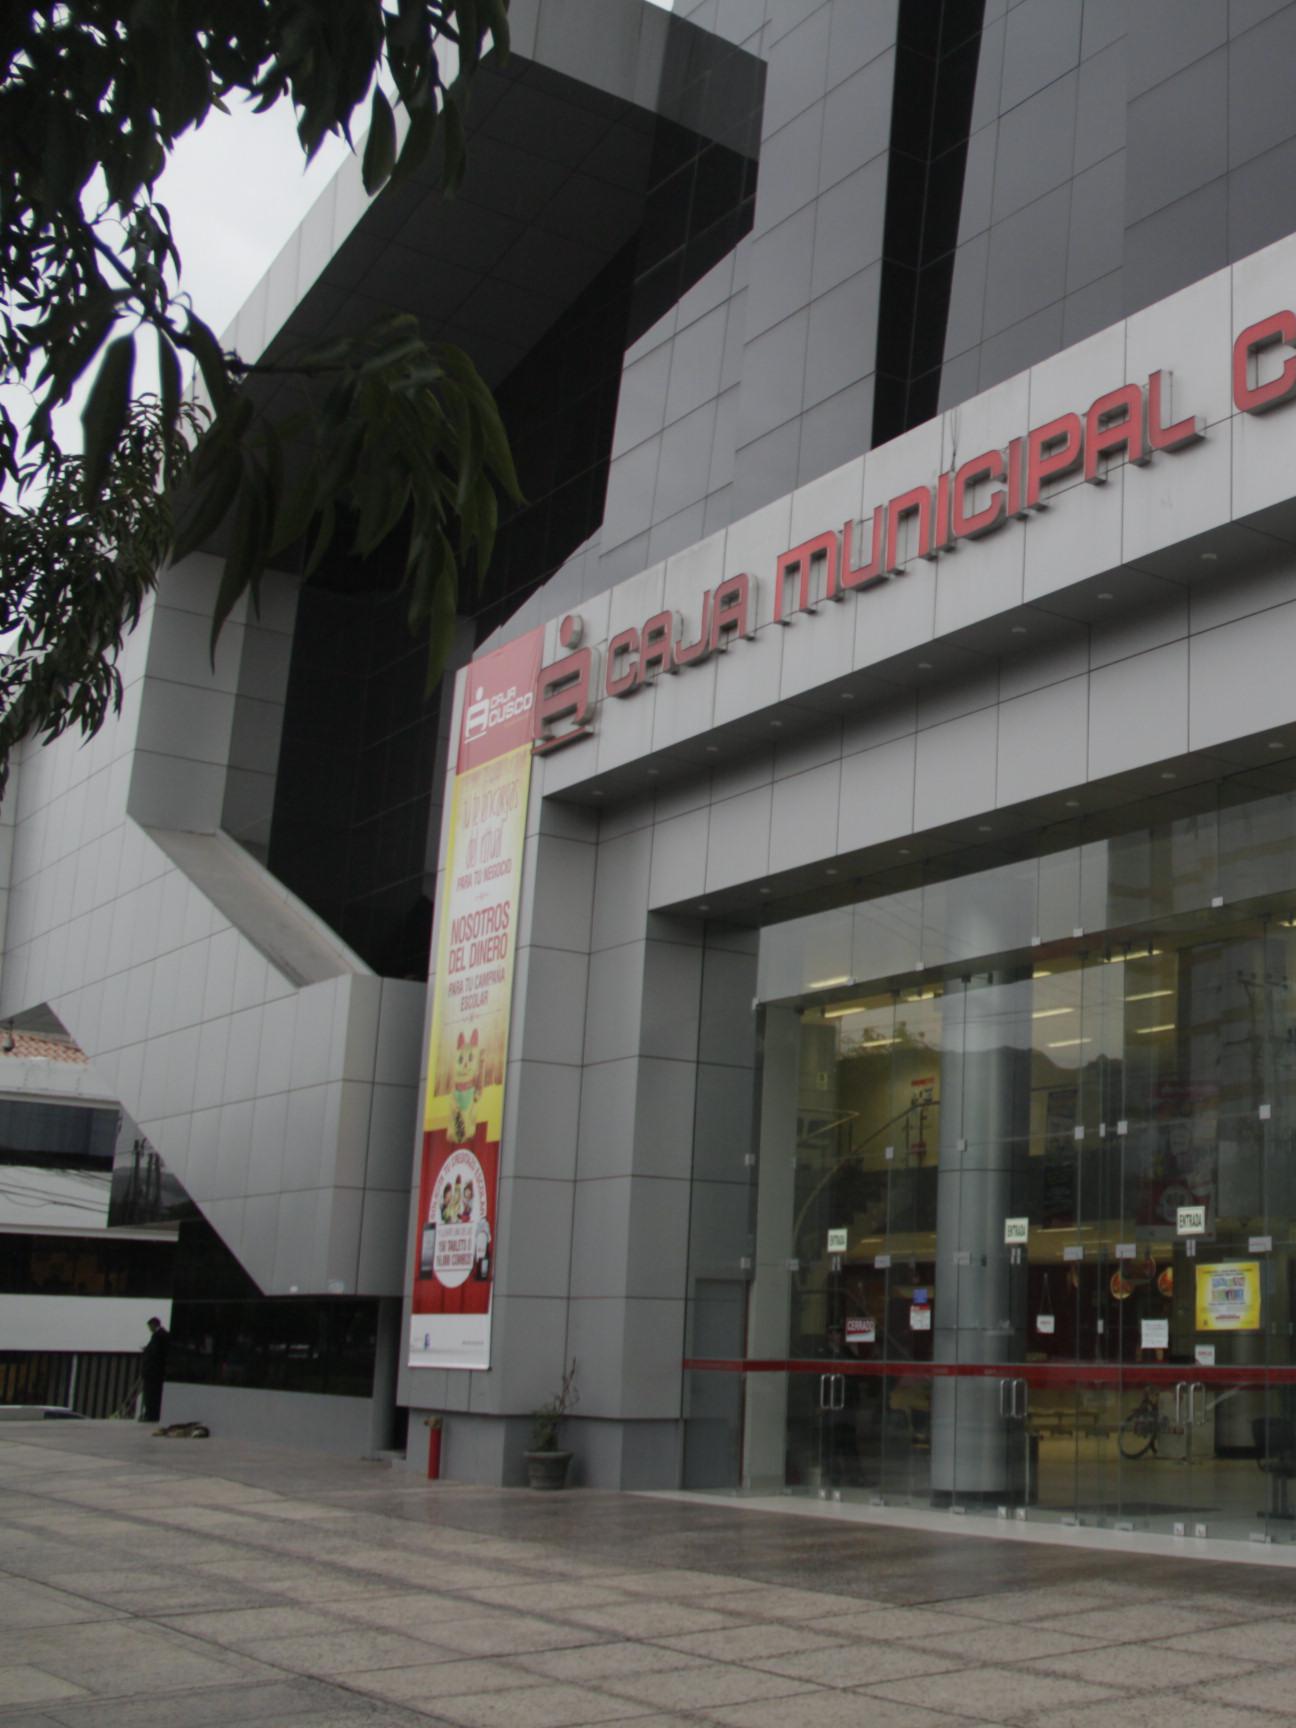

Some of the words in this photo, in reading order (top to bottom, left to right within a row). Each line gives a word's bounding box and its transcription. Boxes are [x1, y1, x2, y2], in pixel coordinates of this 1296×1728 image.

[605, 572, 757, 697] CAJA
[773, 369, 1204, 626] MUNICIPAL
[489, 692, 533, 727] CUSCO
[451, 901, 510, 945] NOSOTROS
[448, 946, 466, 975] DEL
[469, 932, 509, 968] DINERO
[1179, 1213, 1202, 1228] ENTRADA
[847, 1320, 875, 1331] CERRADO
